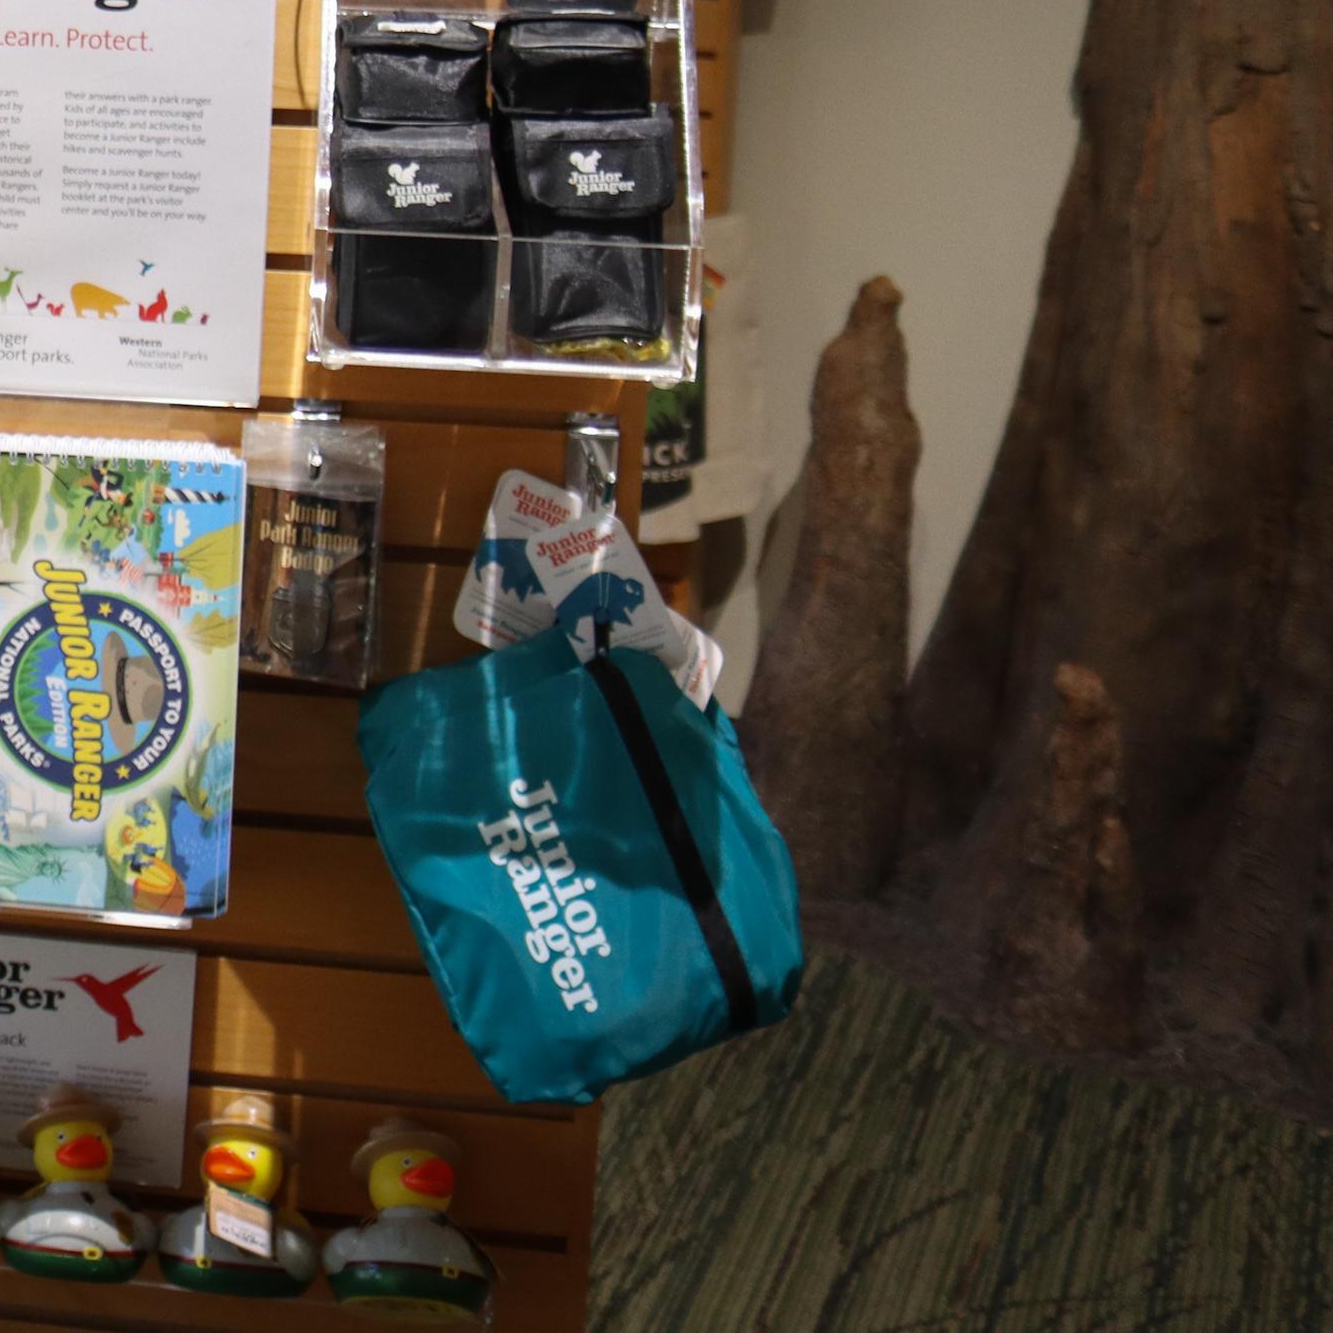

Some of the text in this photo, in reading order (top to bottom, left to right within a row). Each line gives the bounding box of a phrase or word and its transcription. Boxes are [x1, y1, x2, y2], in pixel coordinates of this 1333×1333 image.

[67, 28, 154, 52] Protect.
[88, 93, 125, 102] answers
[128, 94, 149, 103] with
[159, 95, 178, 106] park
[110, 108, 130, 117] ages
[149, 108, 203, 120] encouraged
[387, 181, 439, 197] Junior
[568, 169, 622, 187] Junior
[576, 180, 635, 197] Ranger
[394, 191, 452, 208] Ranger
[119, 336, 163, 348] Western
[138, 348, 208, 362] National Parks
[32, 351, 74, 366] parks.
[127, 358, 183, 371] Association
[285, 500, 337, 528] Junior
[512, 483, 571, 517] Junior
[515, 499, 565, 528] Rang
[260, 520, 359, 553] Park Ranger
[536, 527, 597, 557] Junior
[549, 533, 617, 568] Ranger
[282, 546, 333, 575] Badge
[33, 559, 113, 823] JUNIOR RANGER
[119, 608, 183, 772] PASSPORT TO YOUR
[44, 675, 69, 749] EDITION
[510, 777, 611, 961] Junior
[478, 807, 598, 1014] Ranger
